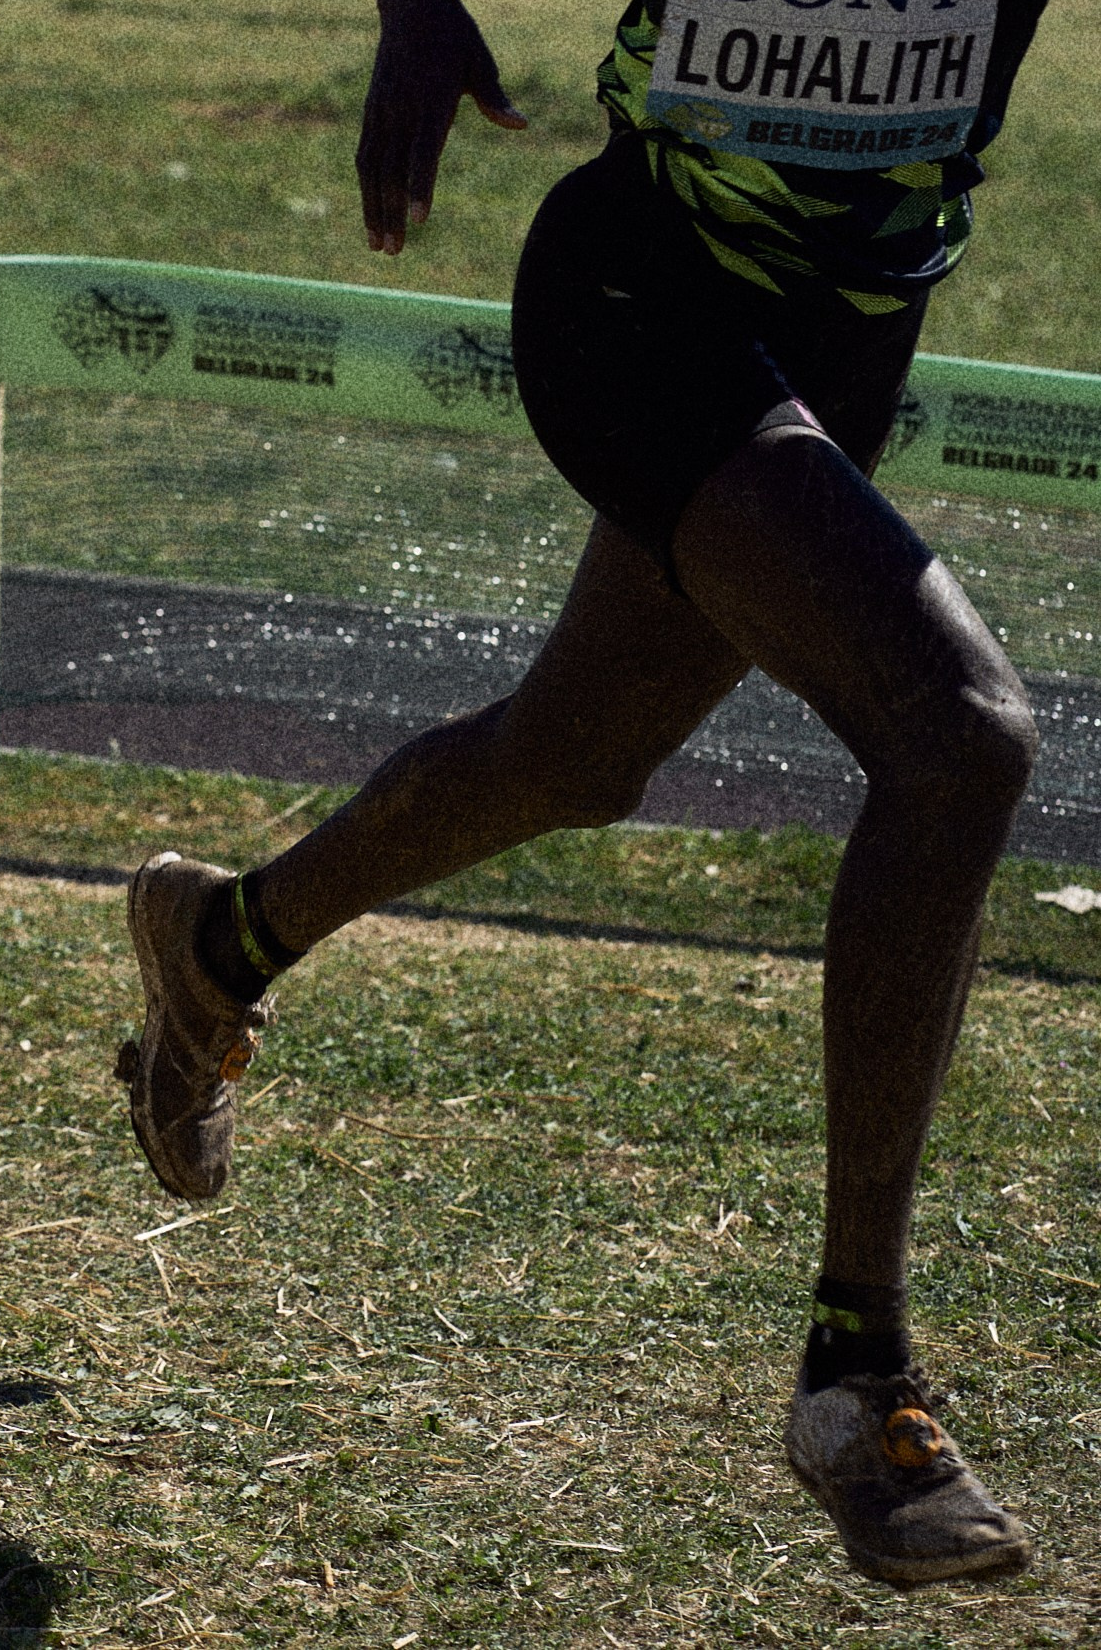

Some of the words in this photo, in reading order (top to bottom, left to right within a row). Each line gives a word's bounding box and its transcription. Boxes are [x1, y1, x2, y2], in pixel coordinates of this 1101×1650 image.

[674, 18, 977, 107] LOHALITH
[746, 120, 916, 154] BELGRADE
[918, 122, 959, 147] 24
